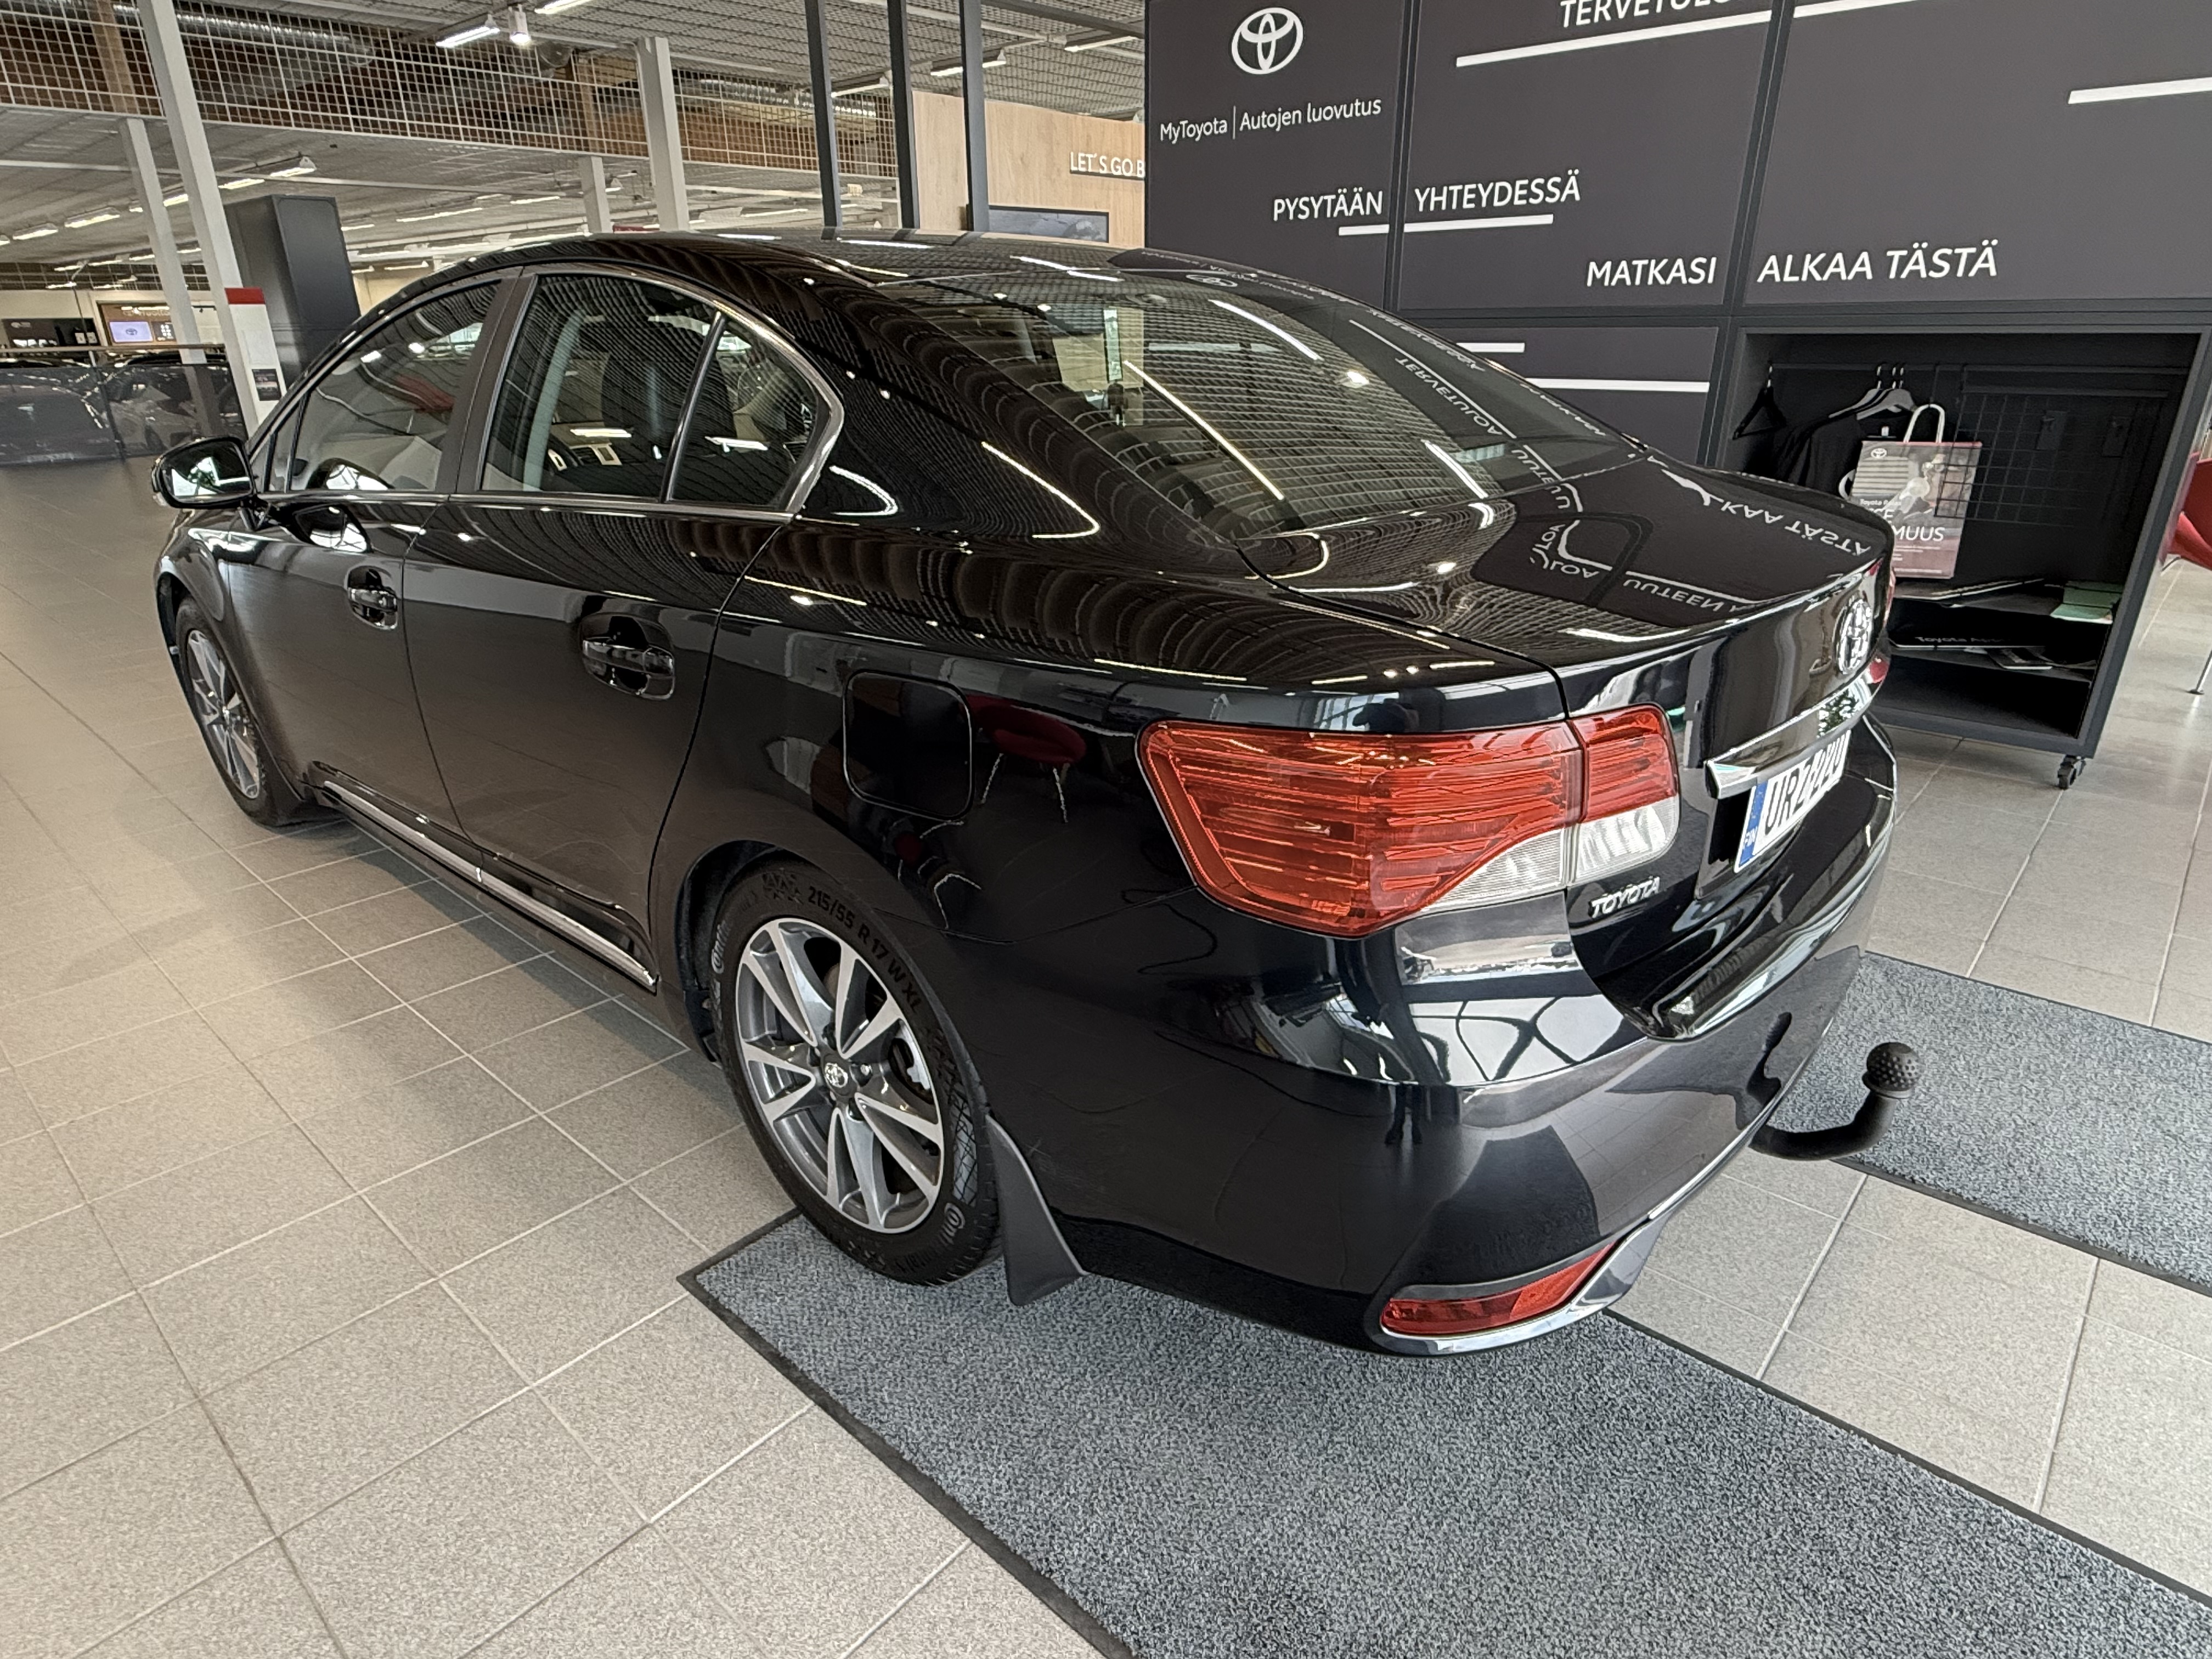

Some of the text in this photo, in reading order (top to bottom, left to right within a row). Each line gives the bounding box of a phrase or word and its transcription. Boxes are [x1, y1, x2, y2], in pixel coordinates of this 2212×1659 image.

[1560, 0, 1730, 27] TERVE
[1160, 98, 1382, 144] MyToyota Autojen luovutus
[1110, 157, 1133, 177] GO
[1273, 168, 1581, 221] PYSYTÄÄN YHTEYDESSÄ
[1586, 239, 1999, 287] MATKASI ALKAA TÄSTÄ
[1591, 877, 1661, 918] TOYOTA
[808, 885, 855, 929] 215/55
[857, 923, 871, 945] R
[871, 938, 889, 960] 17
